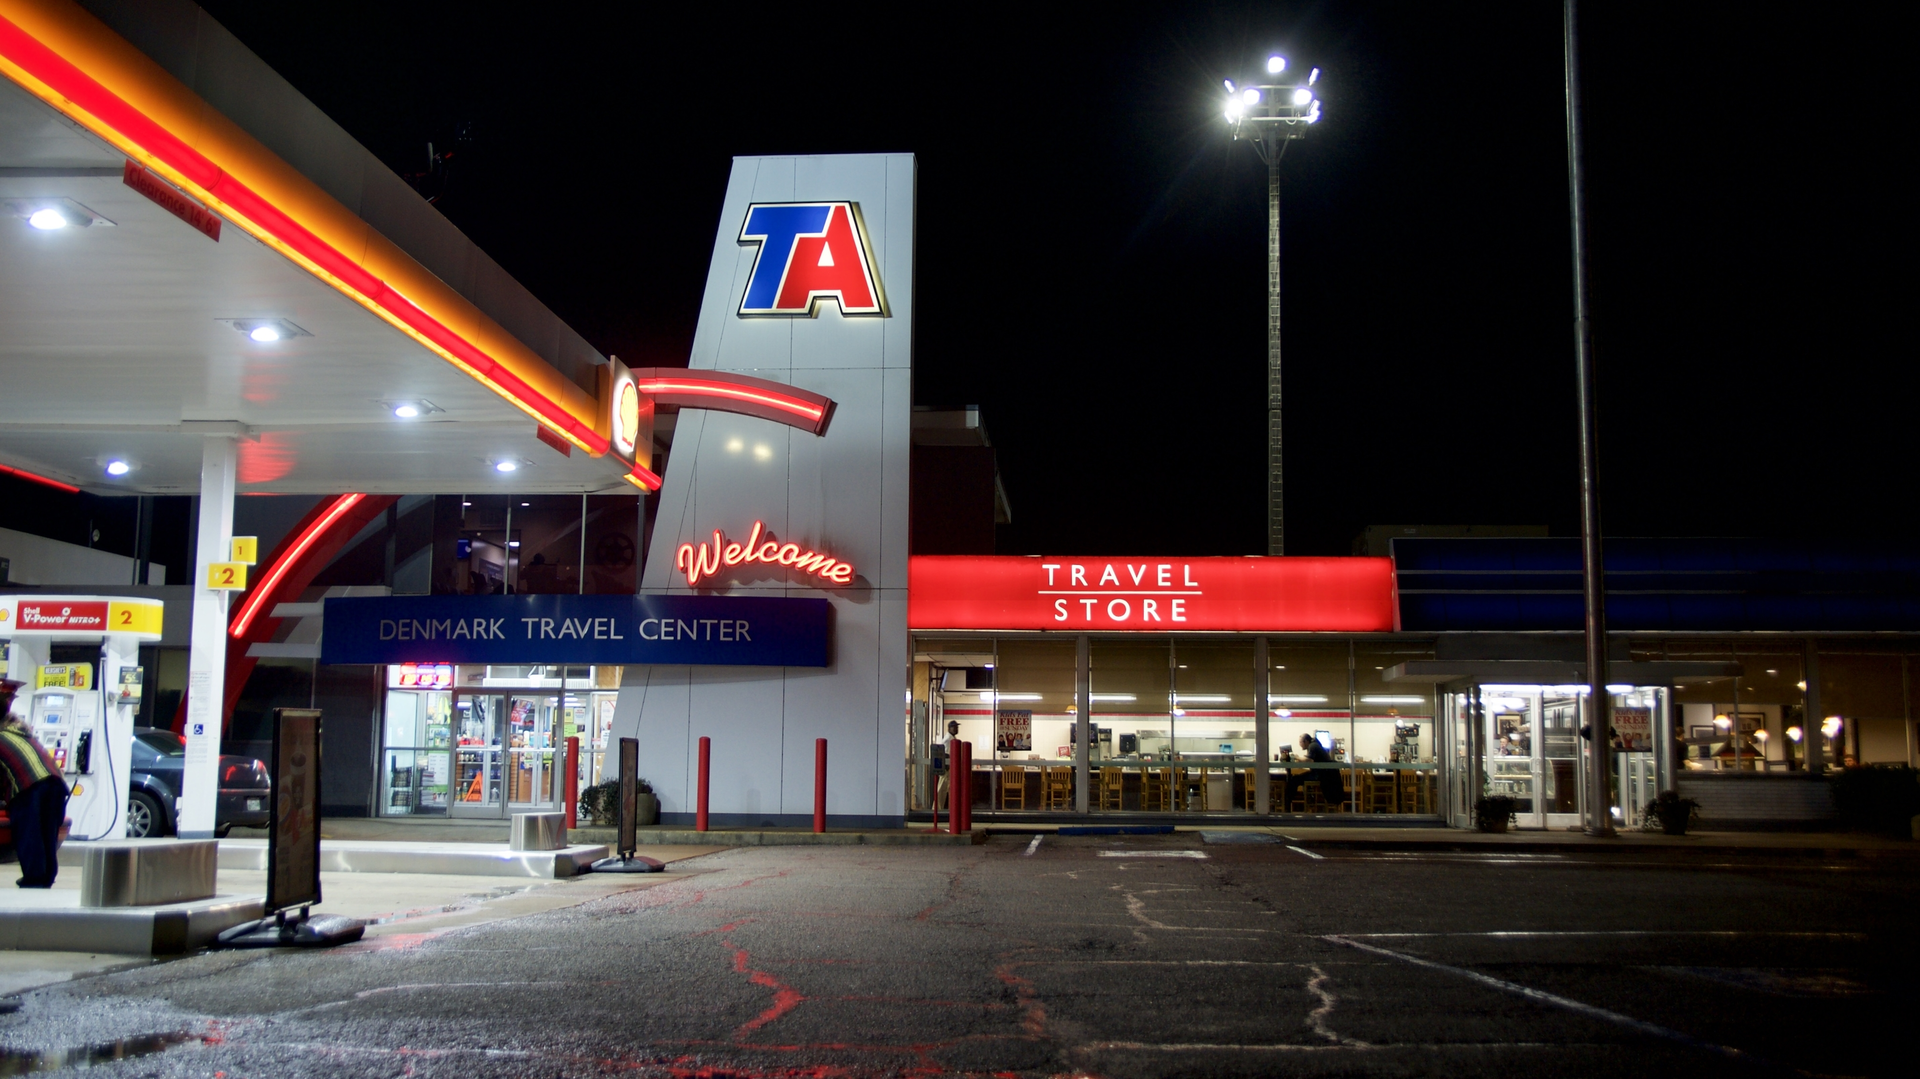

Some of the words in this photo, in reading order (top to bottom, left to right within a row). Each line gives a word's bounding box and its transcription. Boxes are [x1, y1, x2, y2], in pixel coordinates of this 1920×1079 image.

[128, 166, 186, 215] Clearance
[737, 201, 888, 319] TA
[238, 545, 243, 556] 1
[677, 519, 857, 586] Welcome
[221, 567, 235, 585] 2
[1042, 563, 1199, 587] TRAVEL
[23, 606, 41, 614] Shell
[23, 613, 67, 624] V-Power
[120, 610, 133, 625] 2
[1054, 598, 1187, 622] STORE
[379, 618, 506, 641] DENMARK
[521, 617, 624, 640] TRAVEL
[638, 618, 752, 642] CENTER
[999, 717, 1030, 726] FREE
[1615, 715, 1648, 724] FREE
